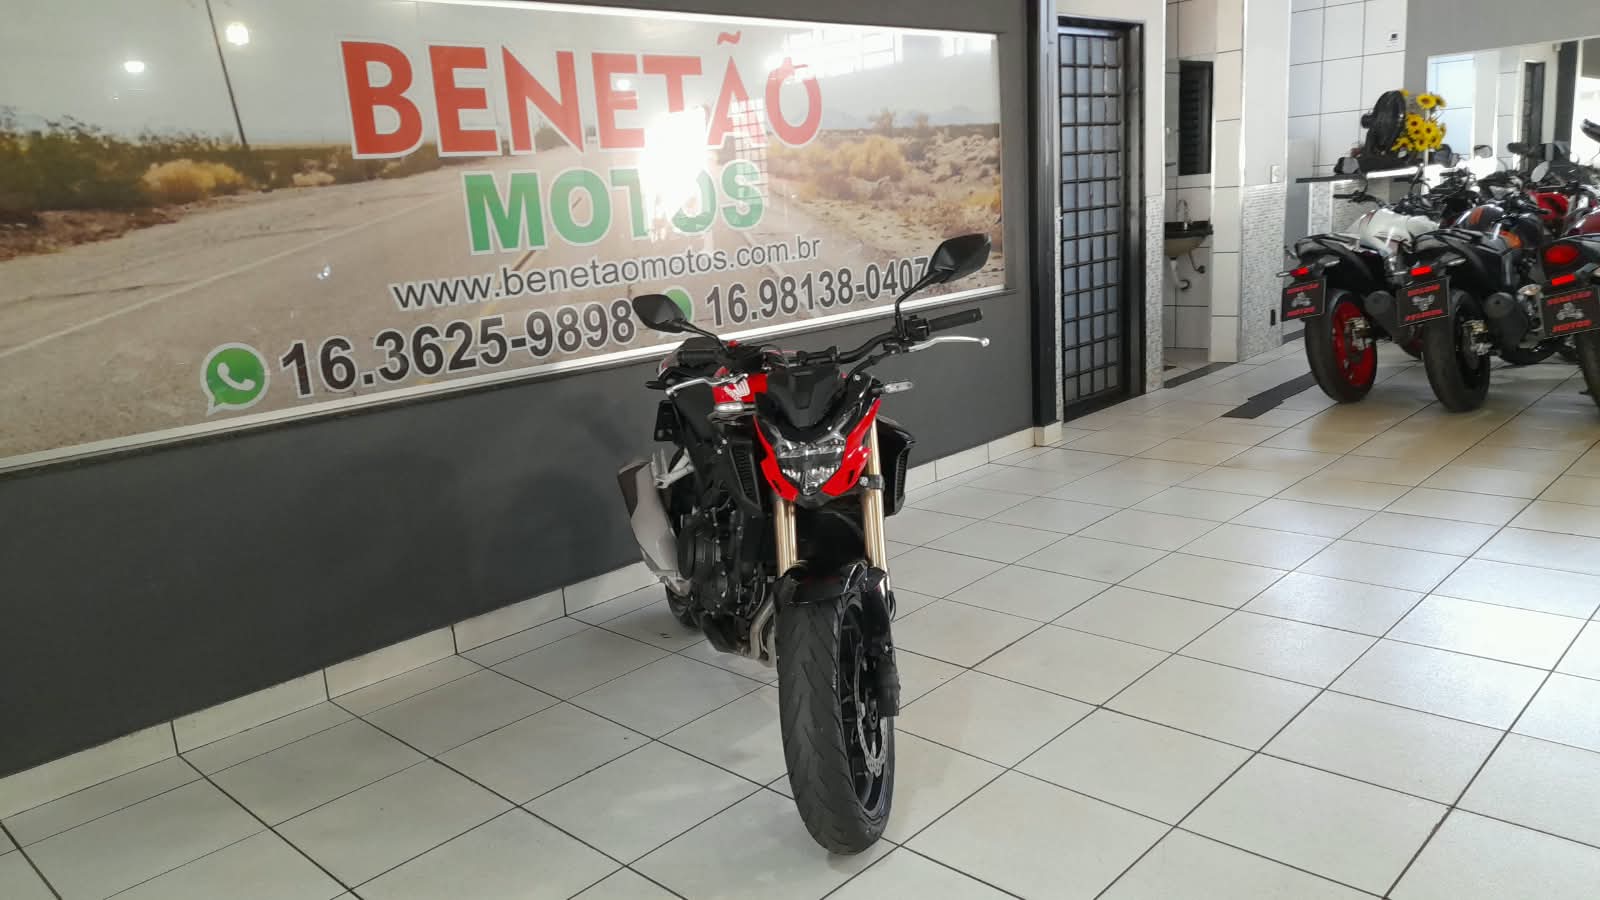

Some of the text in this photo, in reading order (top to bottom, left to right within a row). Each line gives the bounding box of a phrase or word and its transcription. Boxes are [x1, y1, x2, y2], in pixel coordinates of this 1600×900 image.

[340, 30, 822, 155] BENETÃO
[392, 236, 820, 308] www.benetaomotos.com.br
[706, 257, 929, 326] 16.98138-0407
[280, 298, 635, 397] 16.3625-9898
